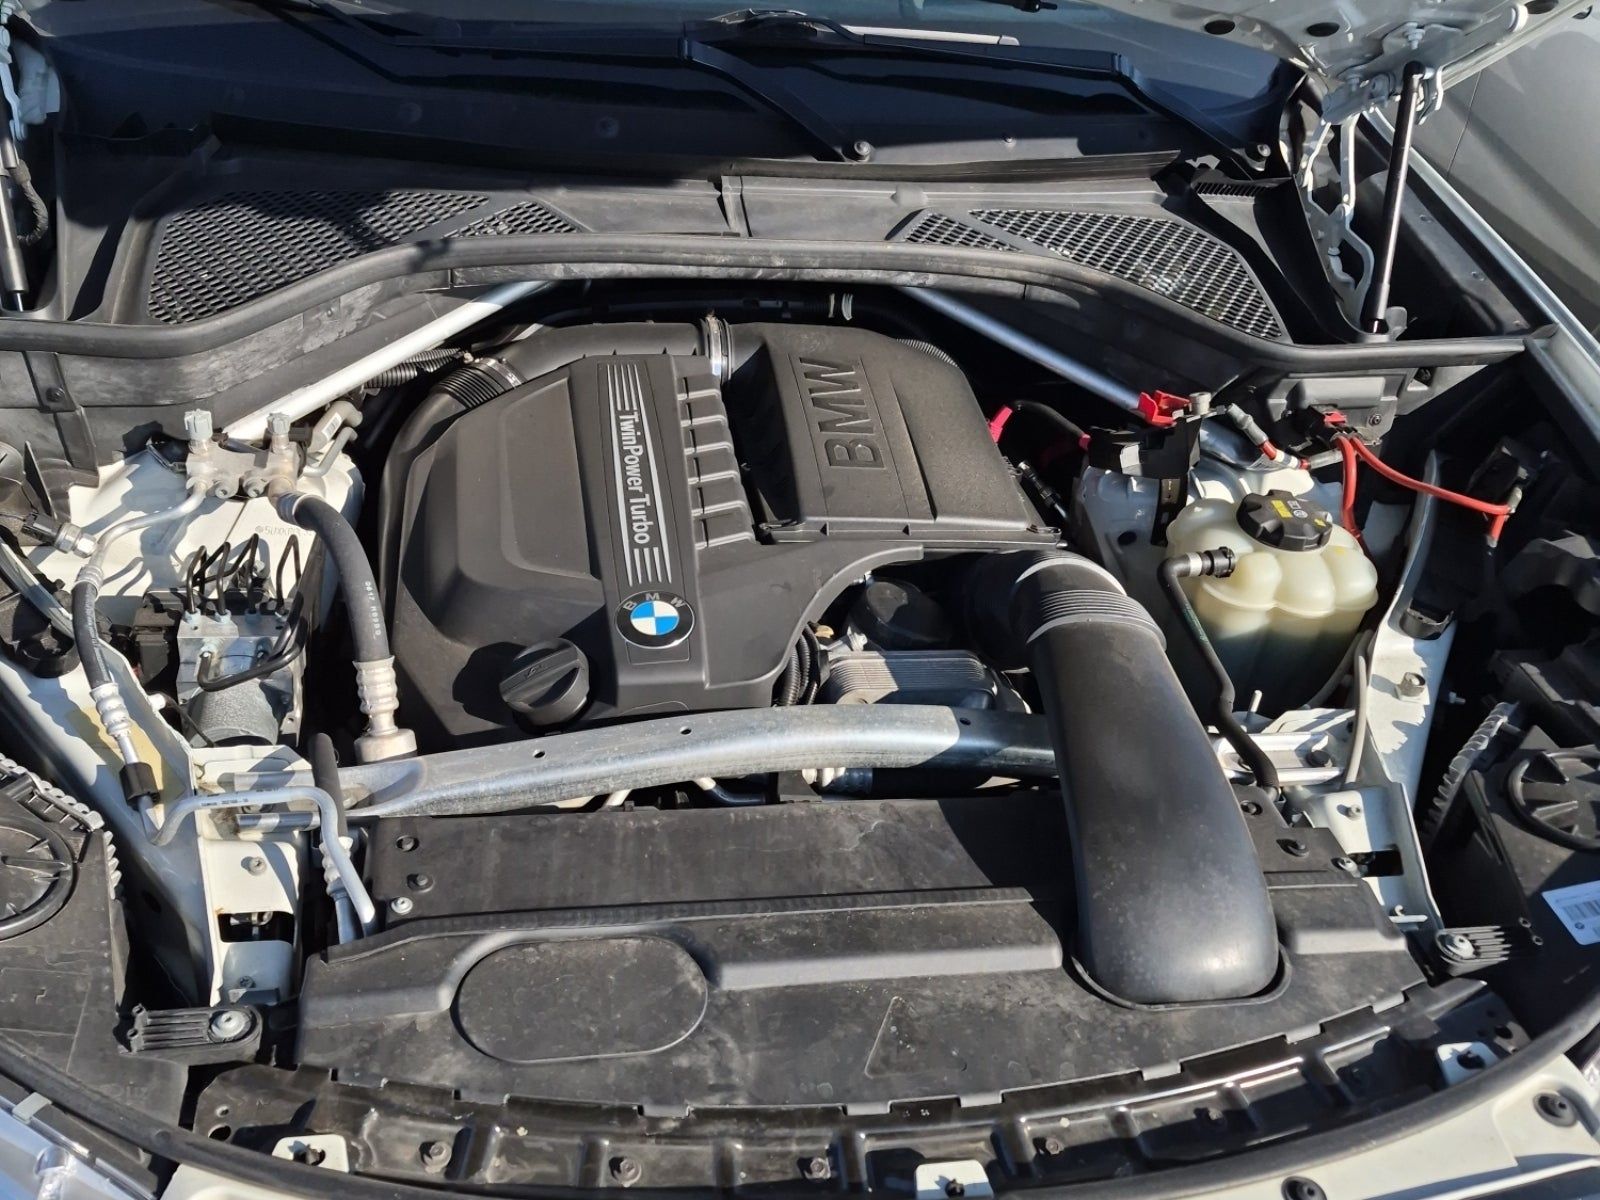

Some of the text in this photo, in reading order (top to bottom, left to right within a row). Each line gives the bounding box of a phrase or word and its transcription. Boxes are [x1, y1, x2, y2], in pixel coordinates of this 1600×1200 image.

[799, 357, 886, 469] BMW
[619, 411, 654, 544] TwinPower Turbo
[623, 592, 687, 611] BMW
